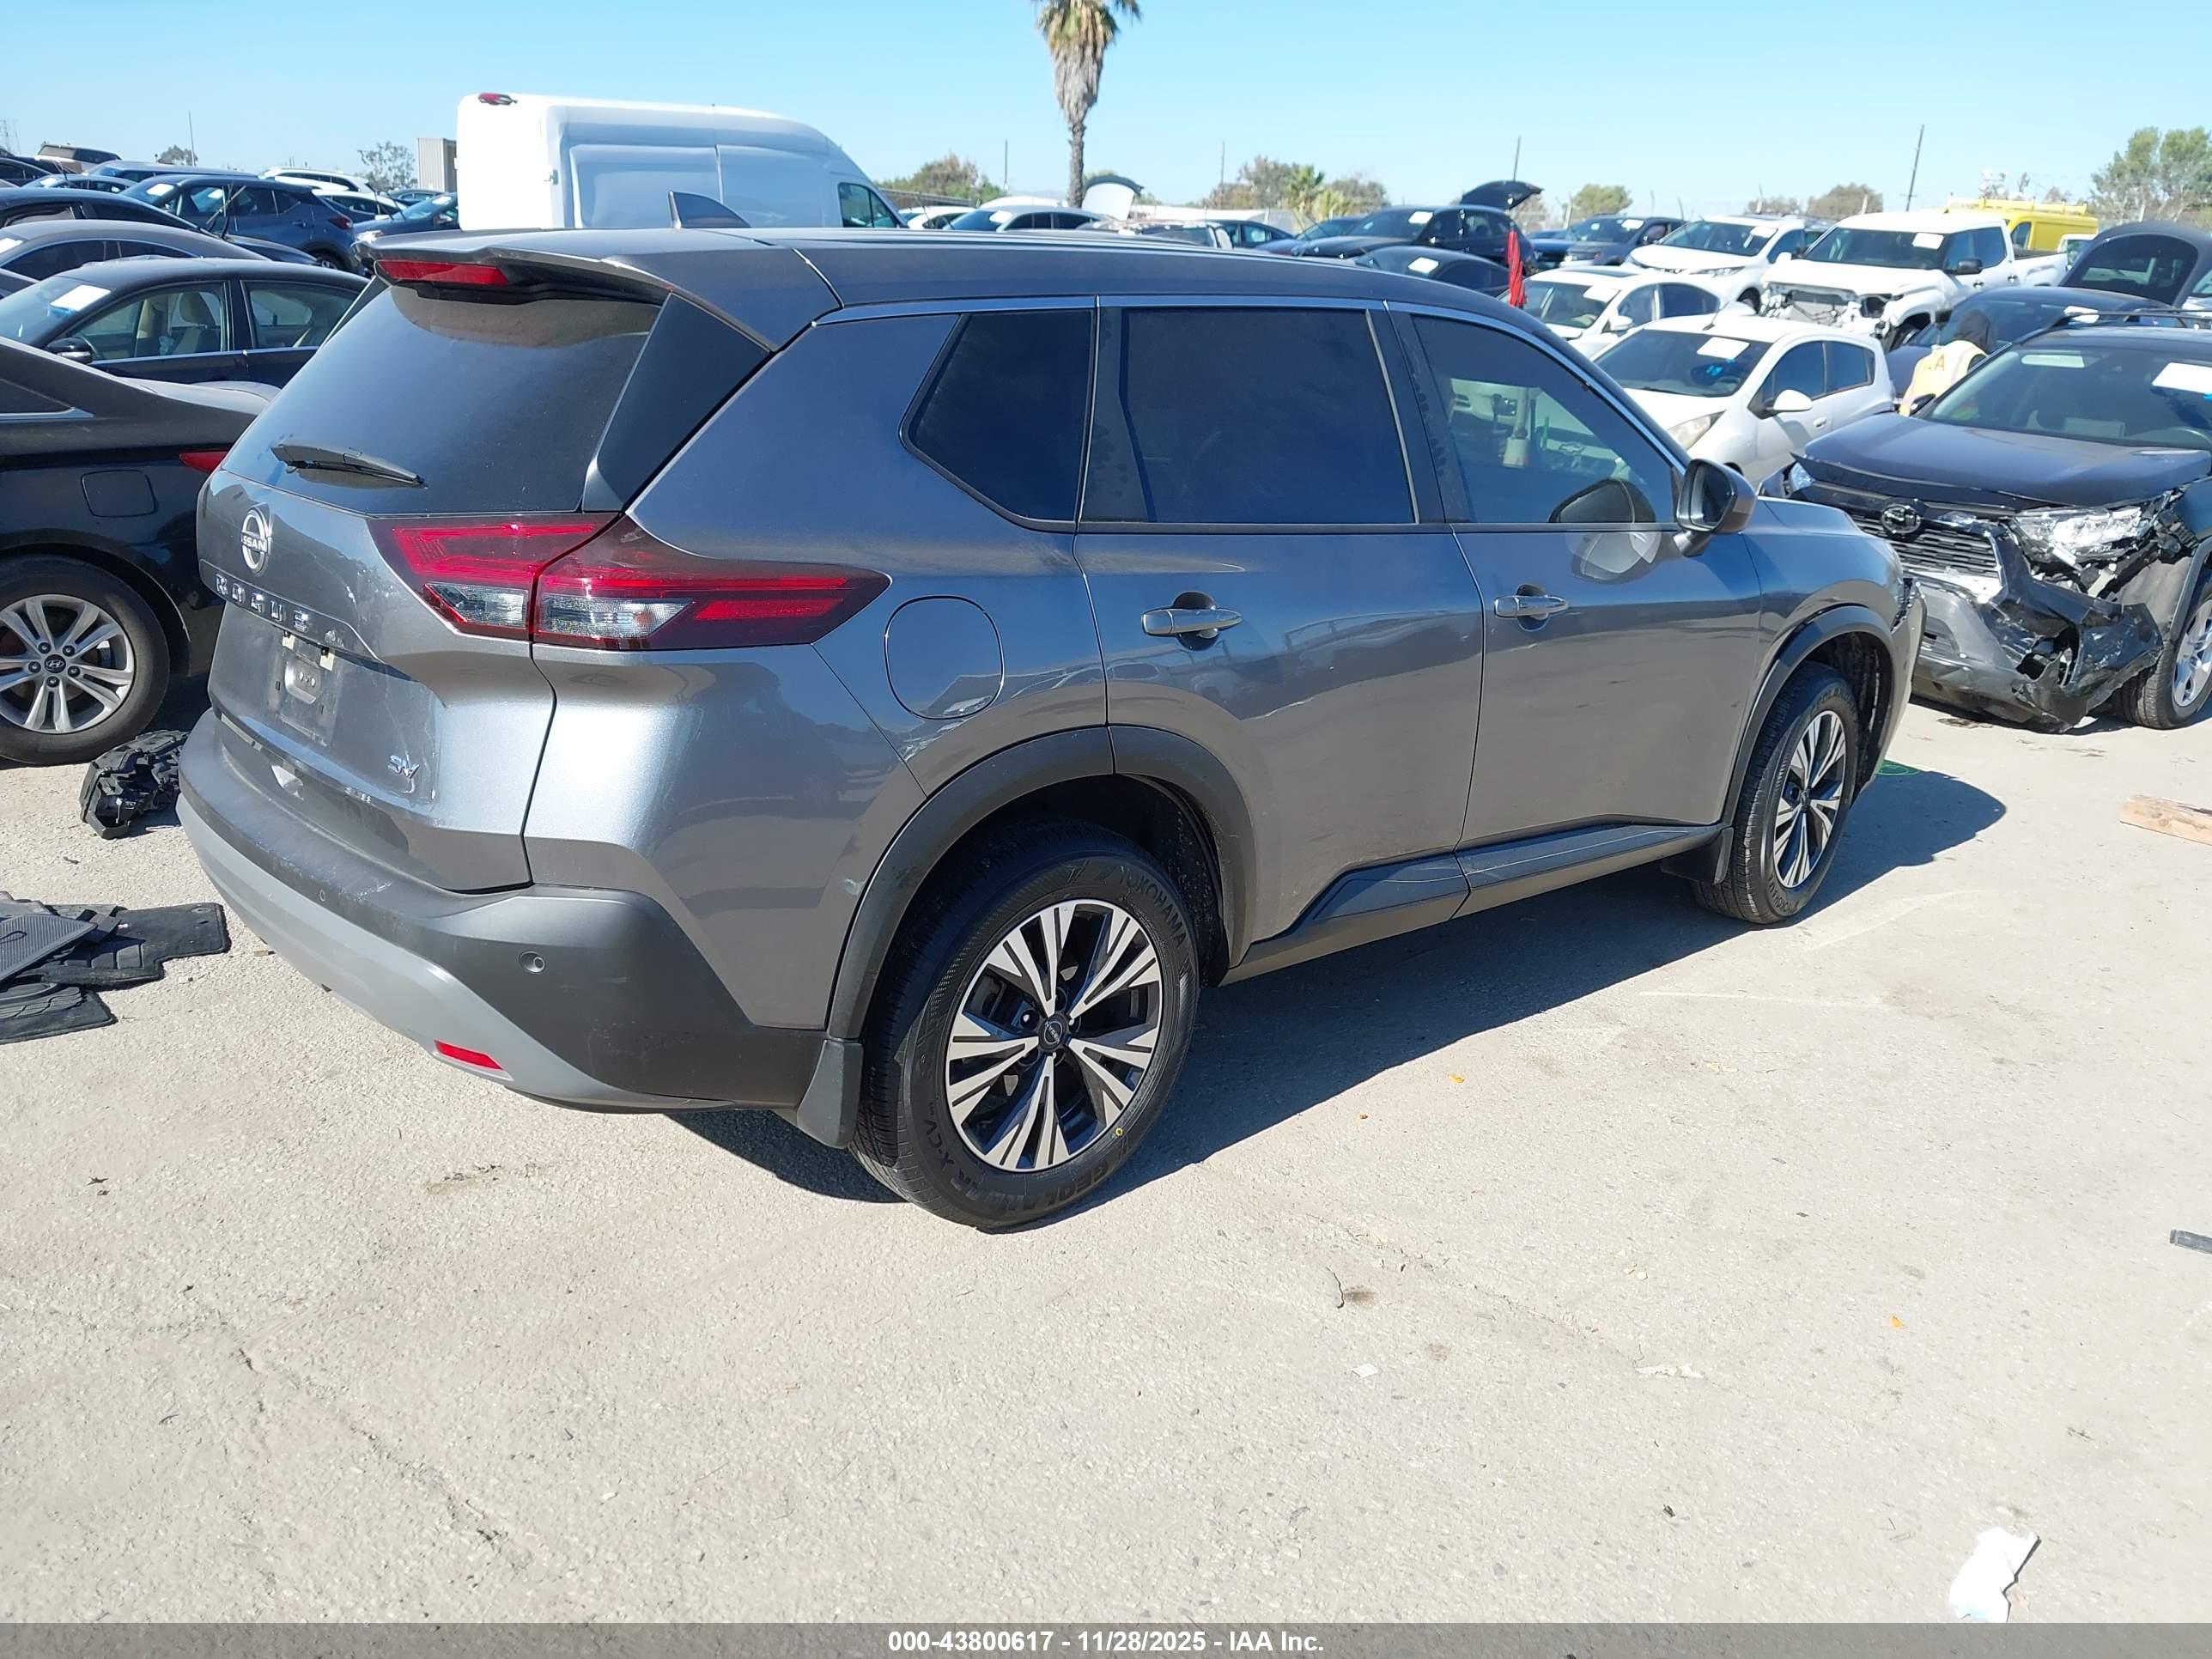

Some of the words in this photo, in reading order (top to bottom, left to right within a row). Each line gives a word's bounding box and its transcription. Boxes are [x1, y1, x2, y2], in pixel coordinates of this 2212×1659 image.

[216, 574, 310, 633] ROGUE
[387, 754, 420, 779] SV
[1120, 866, 1187, 948] YOKOHAMA
